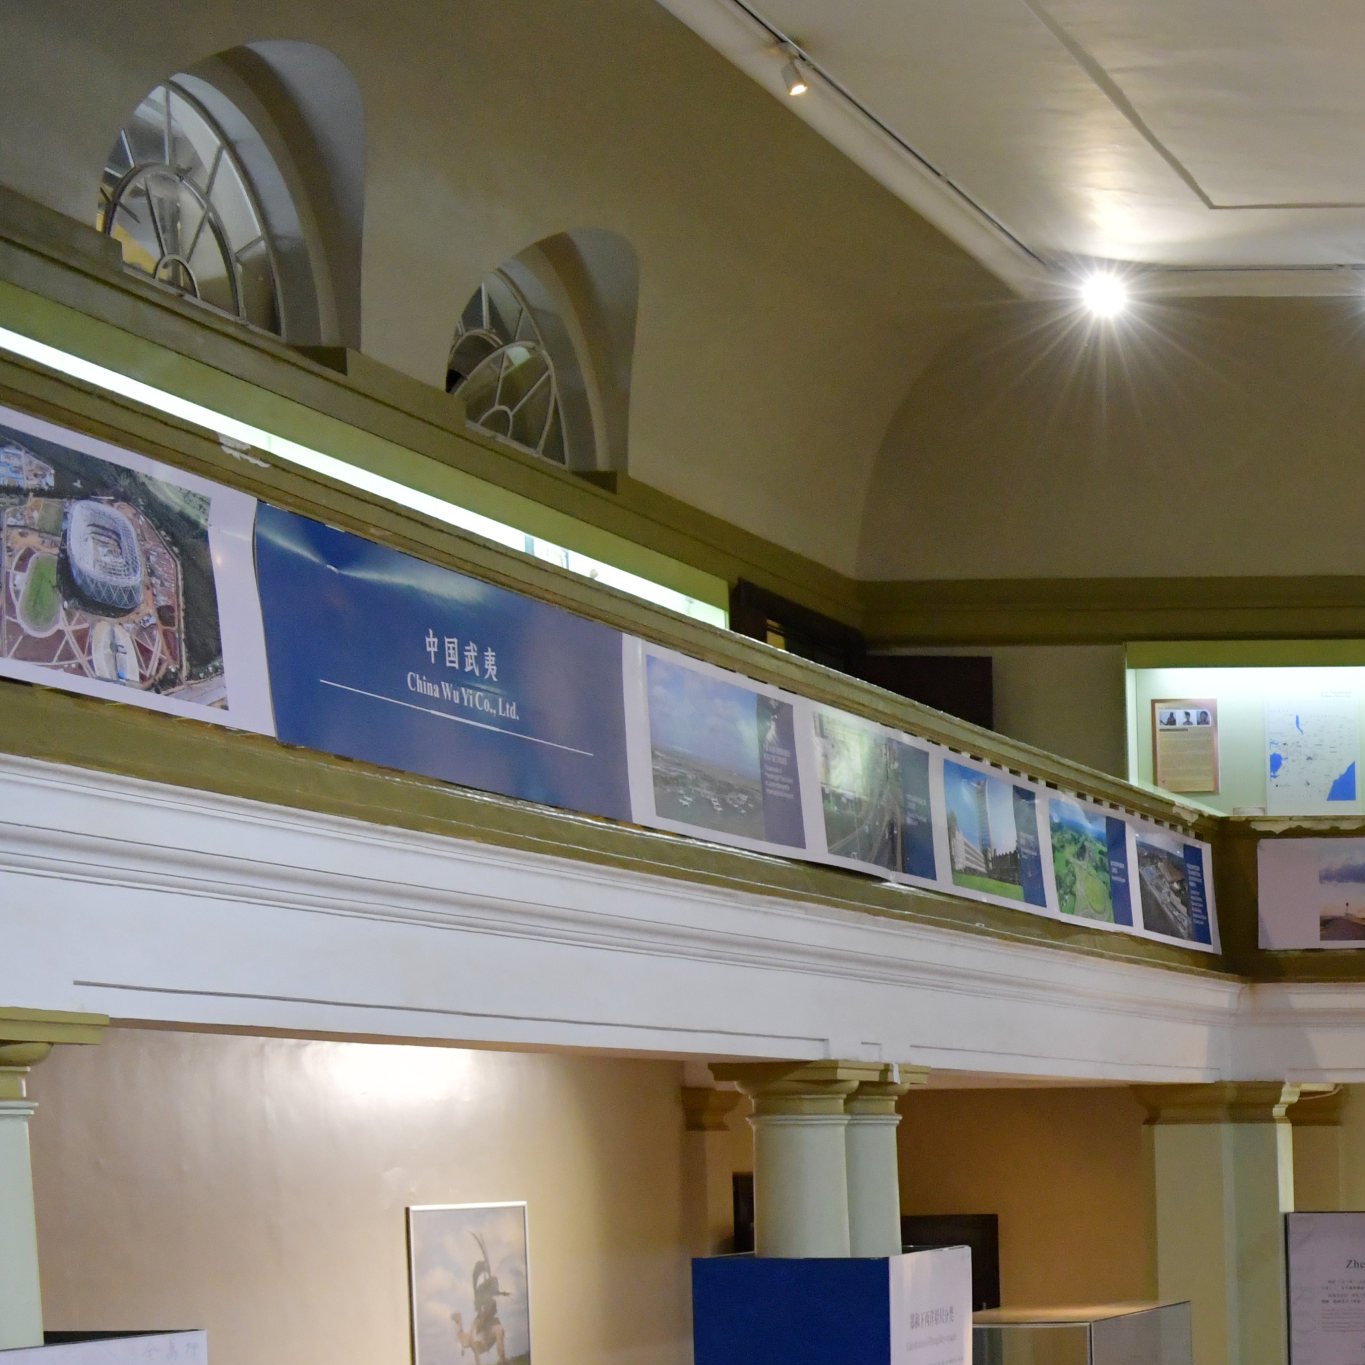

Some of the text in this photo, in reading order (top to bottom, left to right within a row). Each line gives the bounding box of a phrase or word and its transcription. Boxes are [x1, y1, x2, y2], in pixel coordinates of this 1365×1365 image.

[425, 628, 498, 681] 中国武夷
[407, 672, 520, 720] China Wu Yi Co., Ltd.
